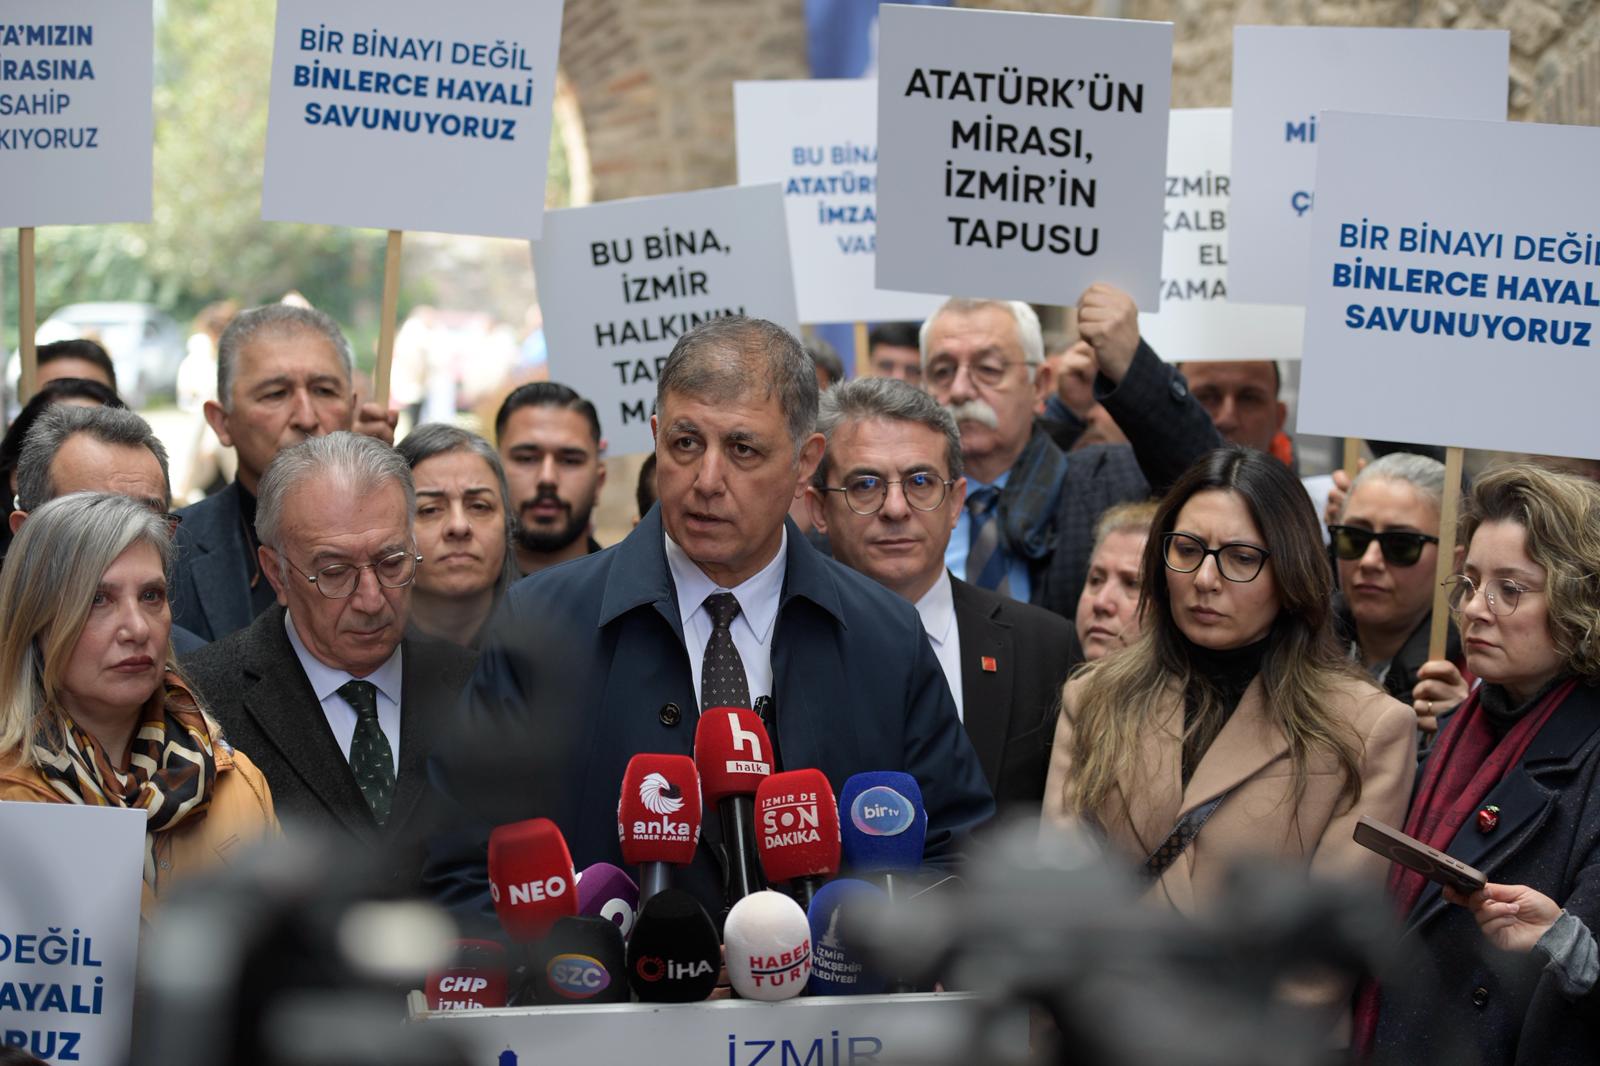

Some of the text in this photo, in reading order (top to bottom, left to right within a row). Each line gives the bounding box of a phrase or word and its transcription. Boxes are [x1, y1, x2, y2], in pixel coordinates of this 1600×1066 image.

[300, 24, 533, 71] BİR BİNAYI DEĞİL
[0, 53, 95, 81] RASINA
[294, 59, 533, 107] BİNLERCE HAYALİ
[905, 66, 1144, 114] ATATÜRK’ÜN
[0, 88, 70, 115] SAHİP
[304, 102, 517, 141] SAVUNUYORUZ
[951, 114, 1093, 164] MİRASI,
[792, 145, 823, 166] BU
[785, 169, 877, 194] ATATÜR
[944, 160, 1096, 208] İZMİR’İN
[591, 227, 731, 266] BU BİNA,
[947, 216, 1099, 256] TAPUSU
[1340, 218, 1390, 251] BİR
[1400, 222, 1503, 259] BİNAYI
[1199, 245, 1227, 265] EL
[622, 266, 708, 303] İZMİR
[1333, 257, 1488, 298] BİNLERCE
[1345, 304, 1592, 347] SAVUNUYORUZ
[735, 762, 763, 773] halk
[800, 793, 817, 801] DE
[632, 815, 690, 835] anka
[764, 829, 821, 849] DAKIKA
[508, 876, 566, 905] NEO
[750, 939, 809, 969] HABER
[816, 945, 845, 961] İZMİR
[553, 963, 601, 988] SZC
[667, 959, 714, 980] İHA
[439, 976, 488, 993] CHP
[728, 1030, 883, 1066] İZMİR
